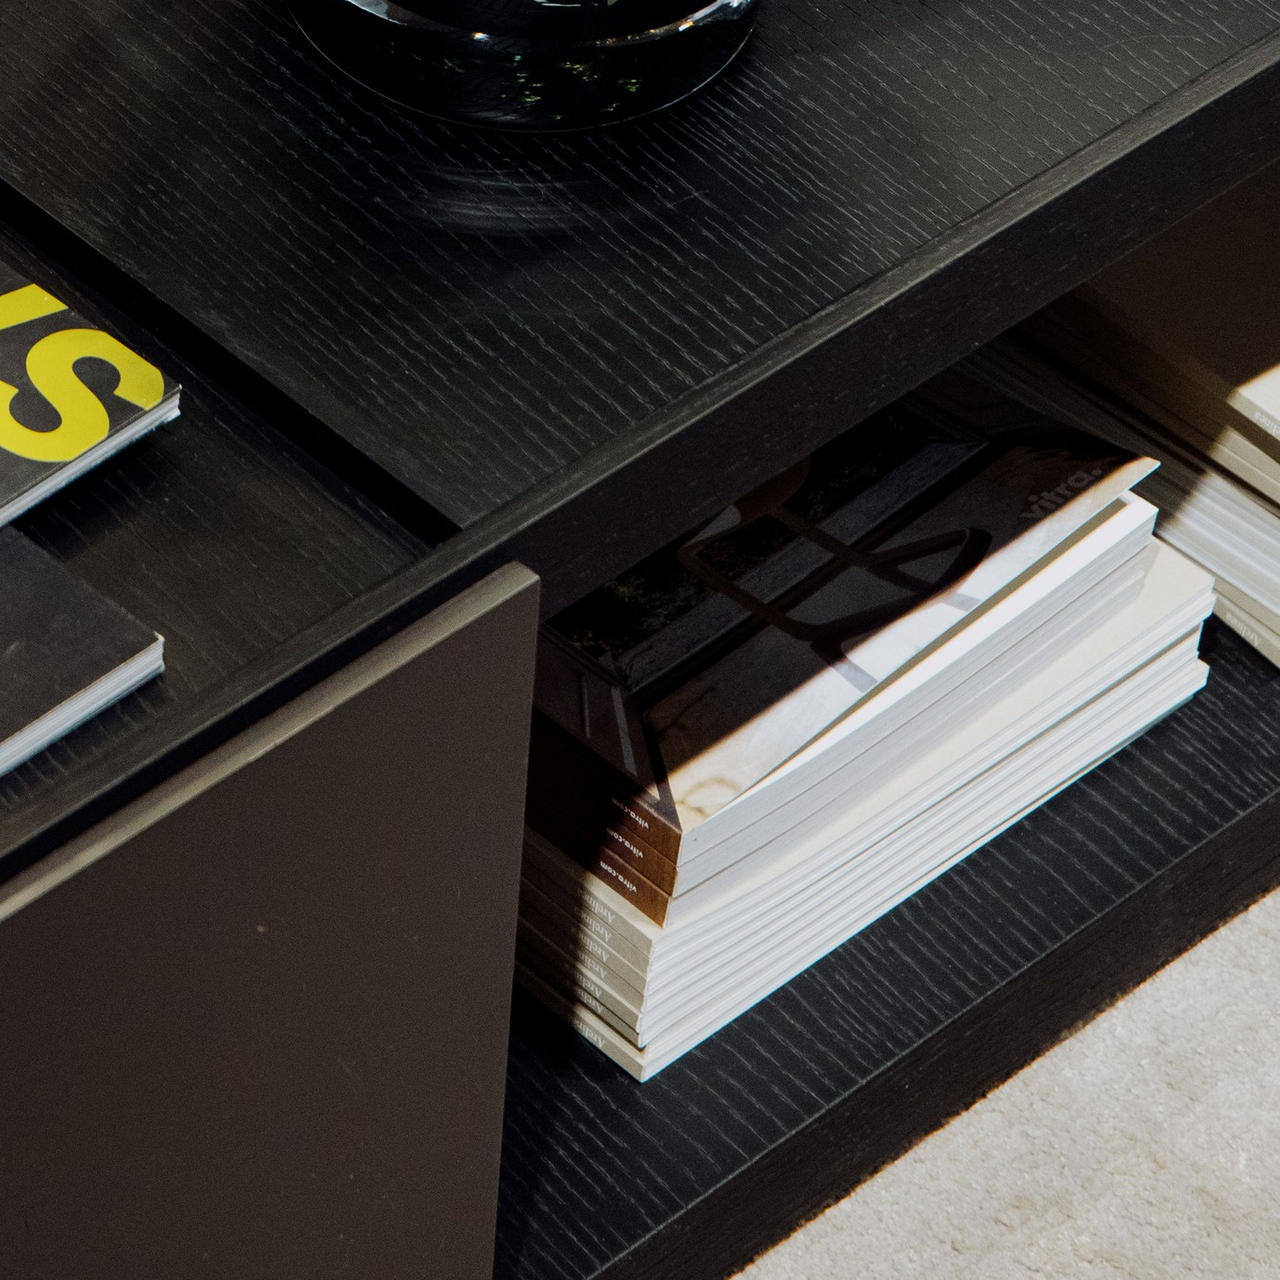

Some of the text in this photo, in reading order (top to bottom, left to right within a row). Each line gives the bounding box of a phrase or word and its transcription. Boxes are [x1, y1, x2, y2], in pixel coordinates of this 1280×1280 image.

[1019, 469, 1102, 519] vitra.
[606, 826, 644, 859] vitra.com
[600, 860, 638, 893] vitra.com
[569, 944, 606, 979] Arclin
[570, 927, 609, 962] Arclin
